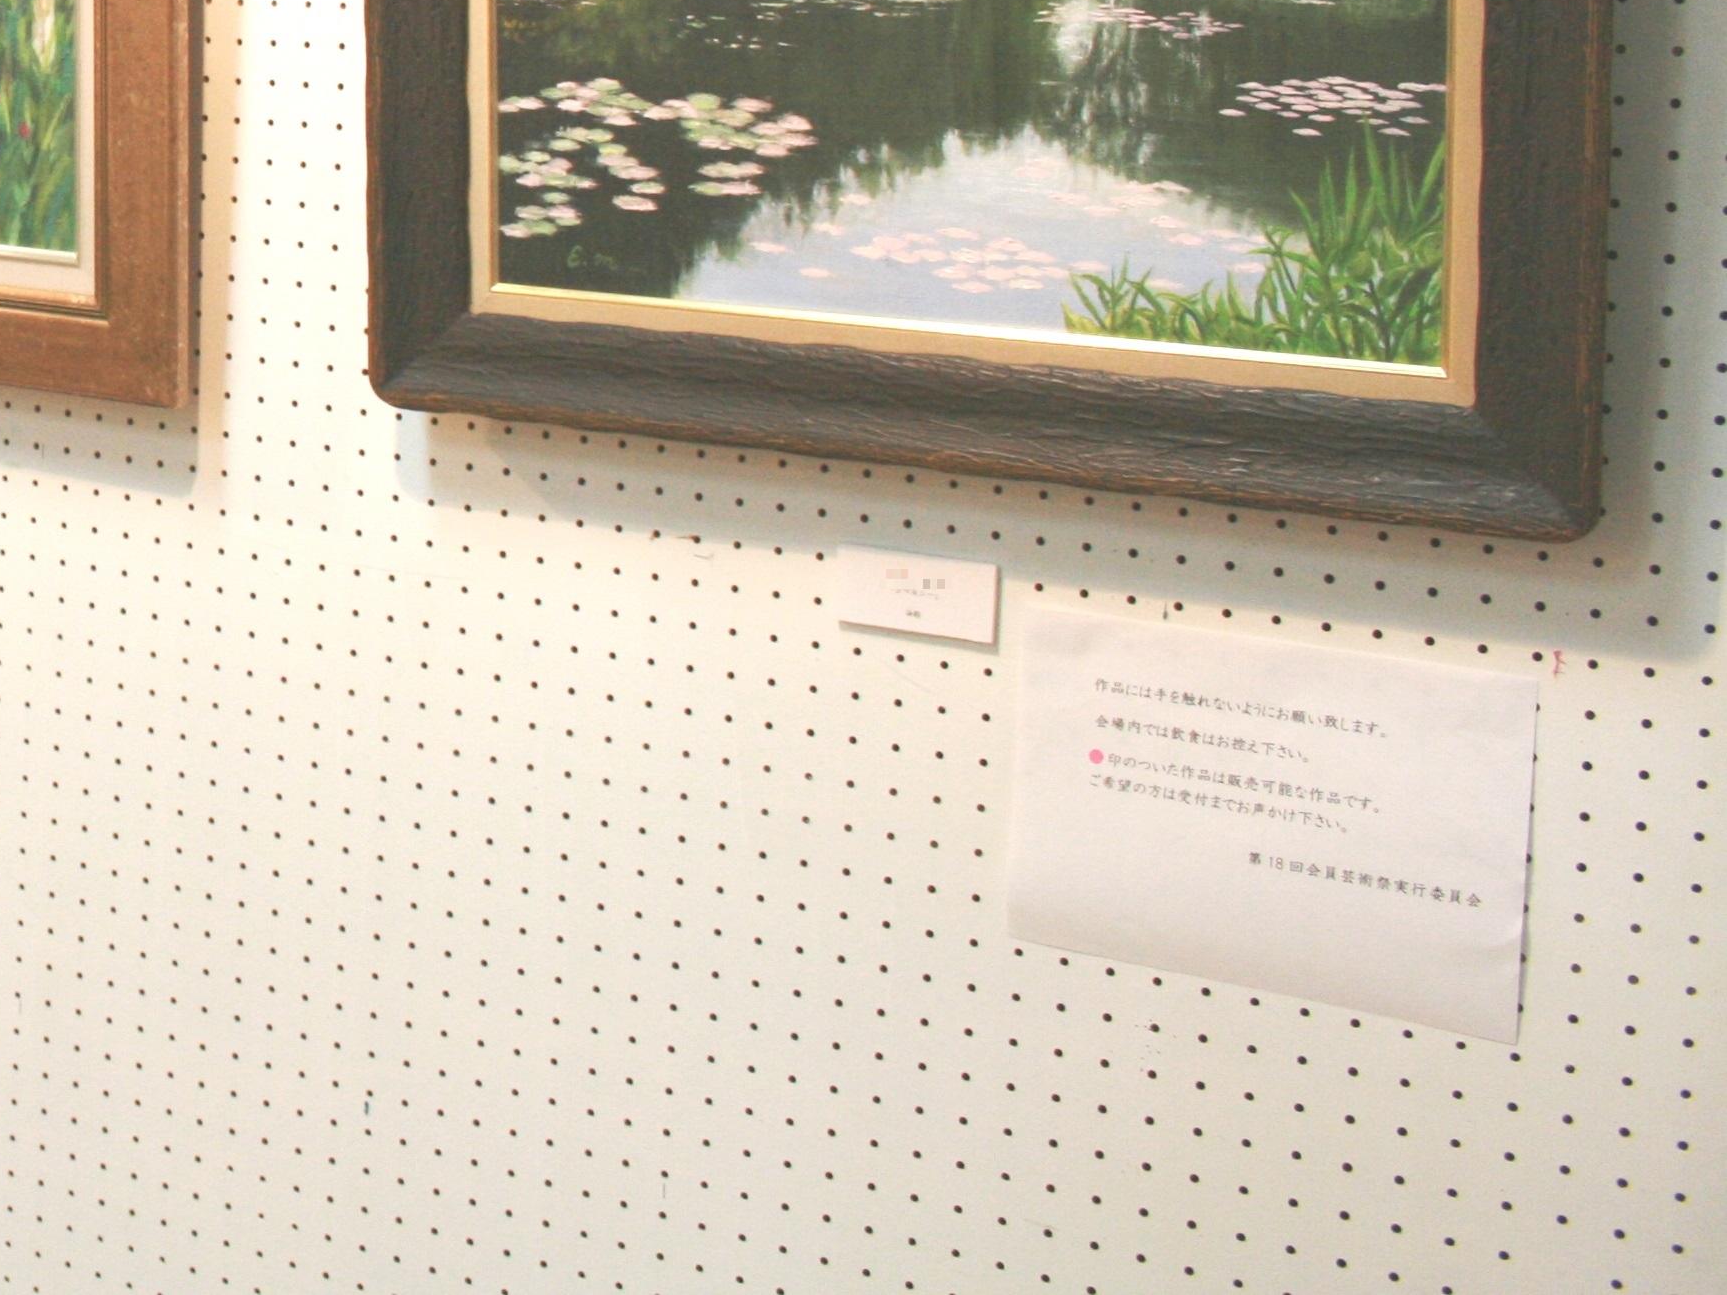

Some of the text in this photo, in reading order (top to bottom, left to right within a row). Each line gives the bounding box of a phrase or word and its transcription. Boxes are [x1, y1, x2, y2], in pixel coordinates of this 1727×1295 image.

[1095, 677, 1388, 738] 作品には手を触れないようにお願い致します。
[1095, 715, 1309, 763] 会場内では飲食はお控え下さい。
[1089, 774, 1347, 833] ご希望の方は受付までお声かけ下さい。
